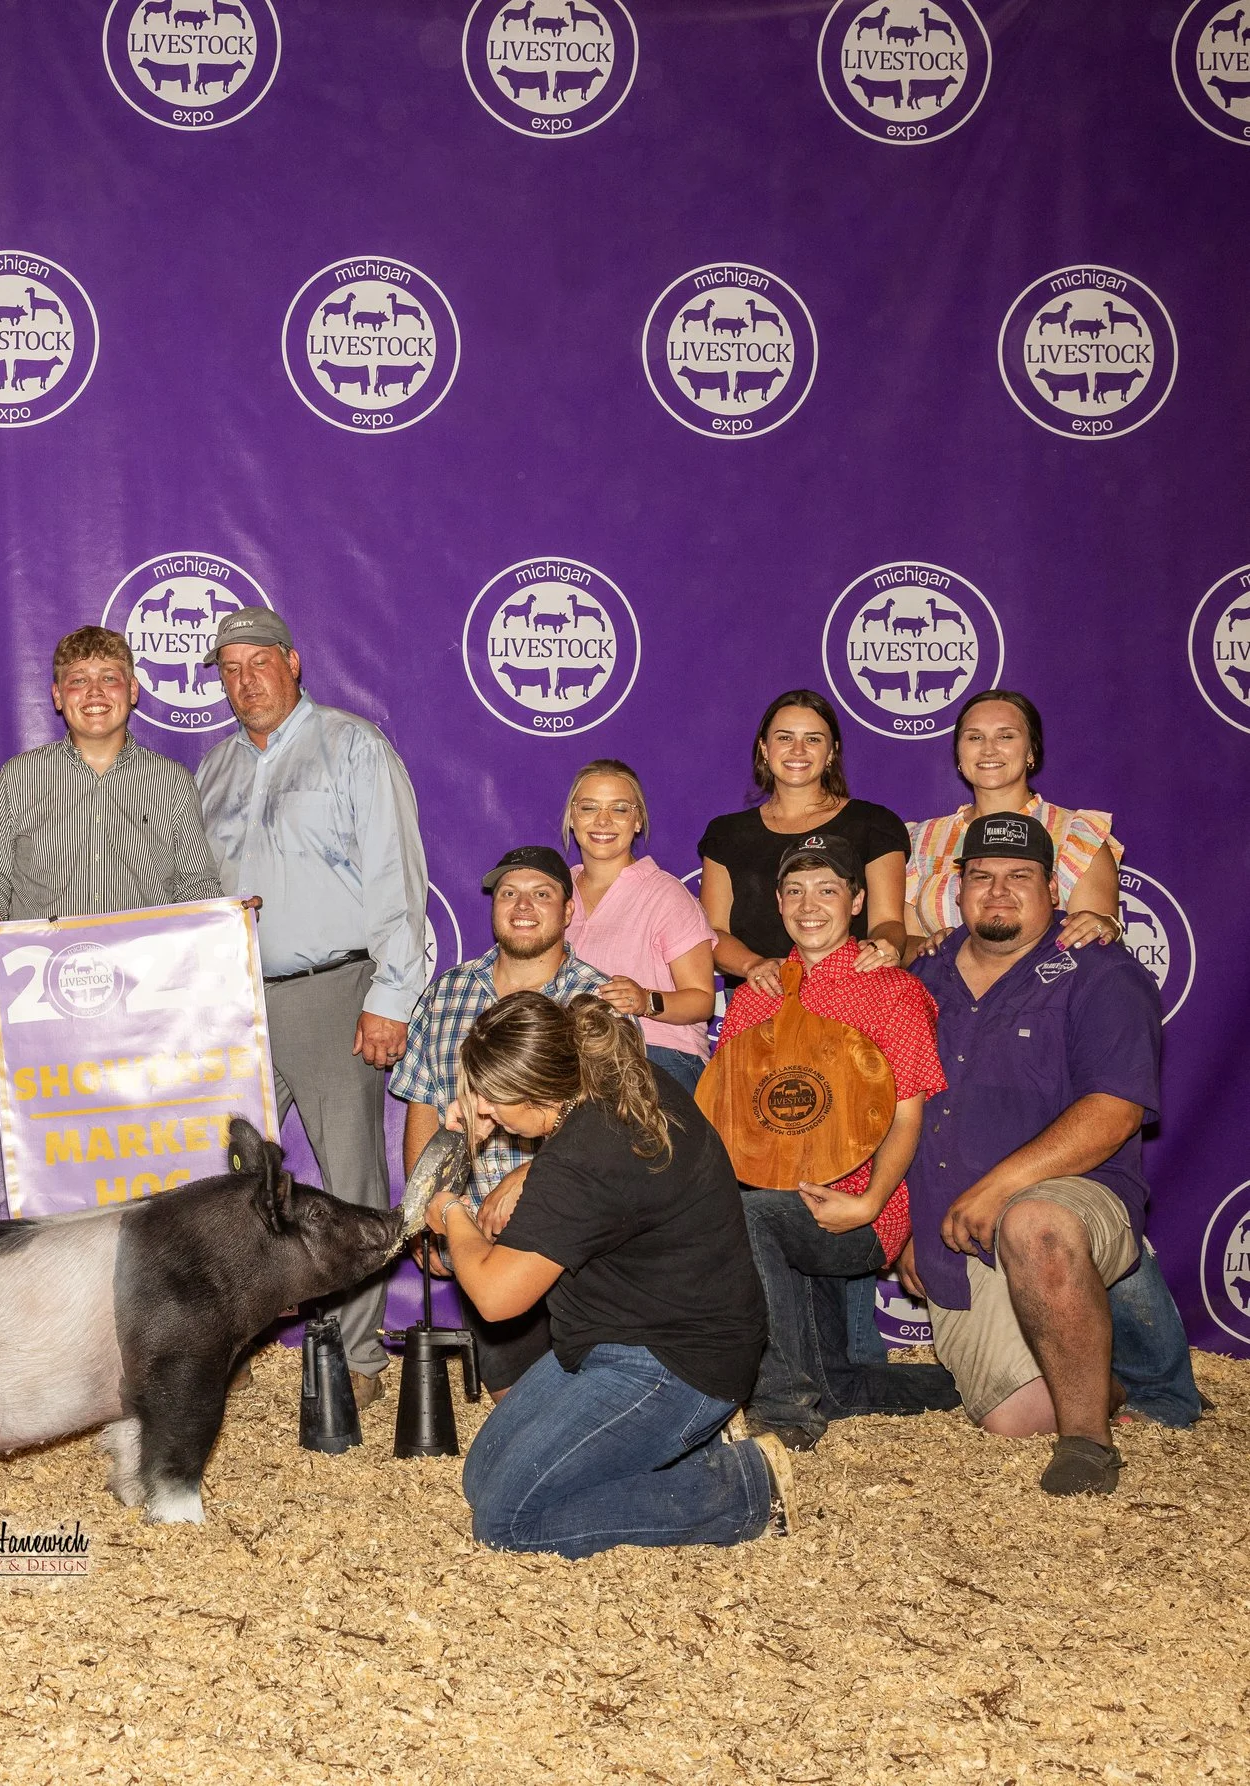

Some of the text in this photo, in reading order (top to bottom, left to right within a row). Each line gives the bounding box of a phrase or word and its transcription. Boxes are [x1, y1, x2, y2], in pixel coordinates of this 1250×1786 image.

[131, 34, 253, 55] LIVESTOCK
[490, 41, 611, 62] LIVESTOCK
[844, 50, 964, 70] LIVESTOCK
[173, 110, 213, 125] expo
[532, 118, 572, 133] expo
[887, 125, 927, 140] expo
[335, 261, 410, 284] michigan
[694, 268, 769, 290] michigan
[1050, 270, 1127, 292] michigan
[310, 335, 433, 356] LIVESTOCK
[670, 342, 791, 362] LIVESTOCK
[1027, 344, 1151, 363] LIVESTOCK
[352, 413, 393, 428] expo
[712, 419, 752, 434] expo
[1072, 420, 1112, 435] expo
[154, 557, 229, 580] michigan
[516, 562, 591, 585] michigan
[874, 567, 950, 589] michigan
[128, 632, 217, 653] LIVESTO
[491, 638, 613, 658] LIVESTOCK
[850, 642, 975, 661] LIVESTOCK
[171, 712, 211, 727] expo
[533, 716, 574, 731] expo
[894, 719, 935, 734] expo
[59, 974, 113, 988] LIVESTOCK
[759, 1070, 777, 1087] GREAT
[803, 1066, 825, 1081] GRAND
[770, 1096, 816, 1105] LIVESTOCK
[823, 1080, 833, 1115] CHAMPION
[759, 1120, 784, 1135] MARKET
[786, 1116, 825, 1136] CROSSBRED
[45, 1114, 229, 1166] MARKET
[900, 1325, 931, 1340] exp
